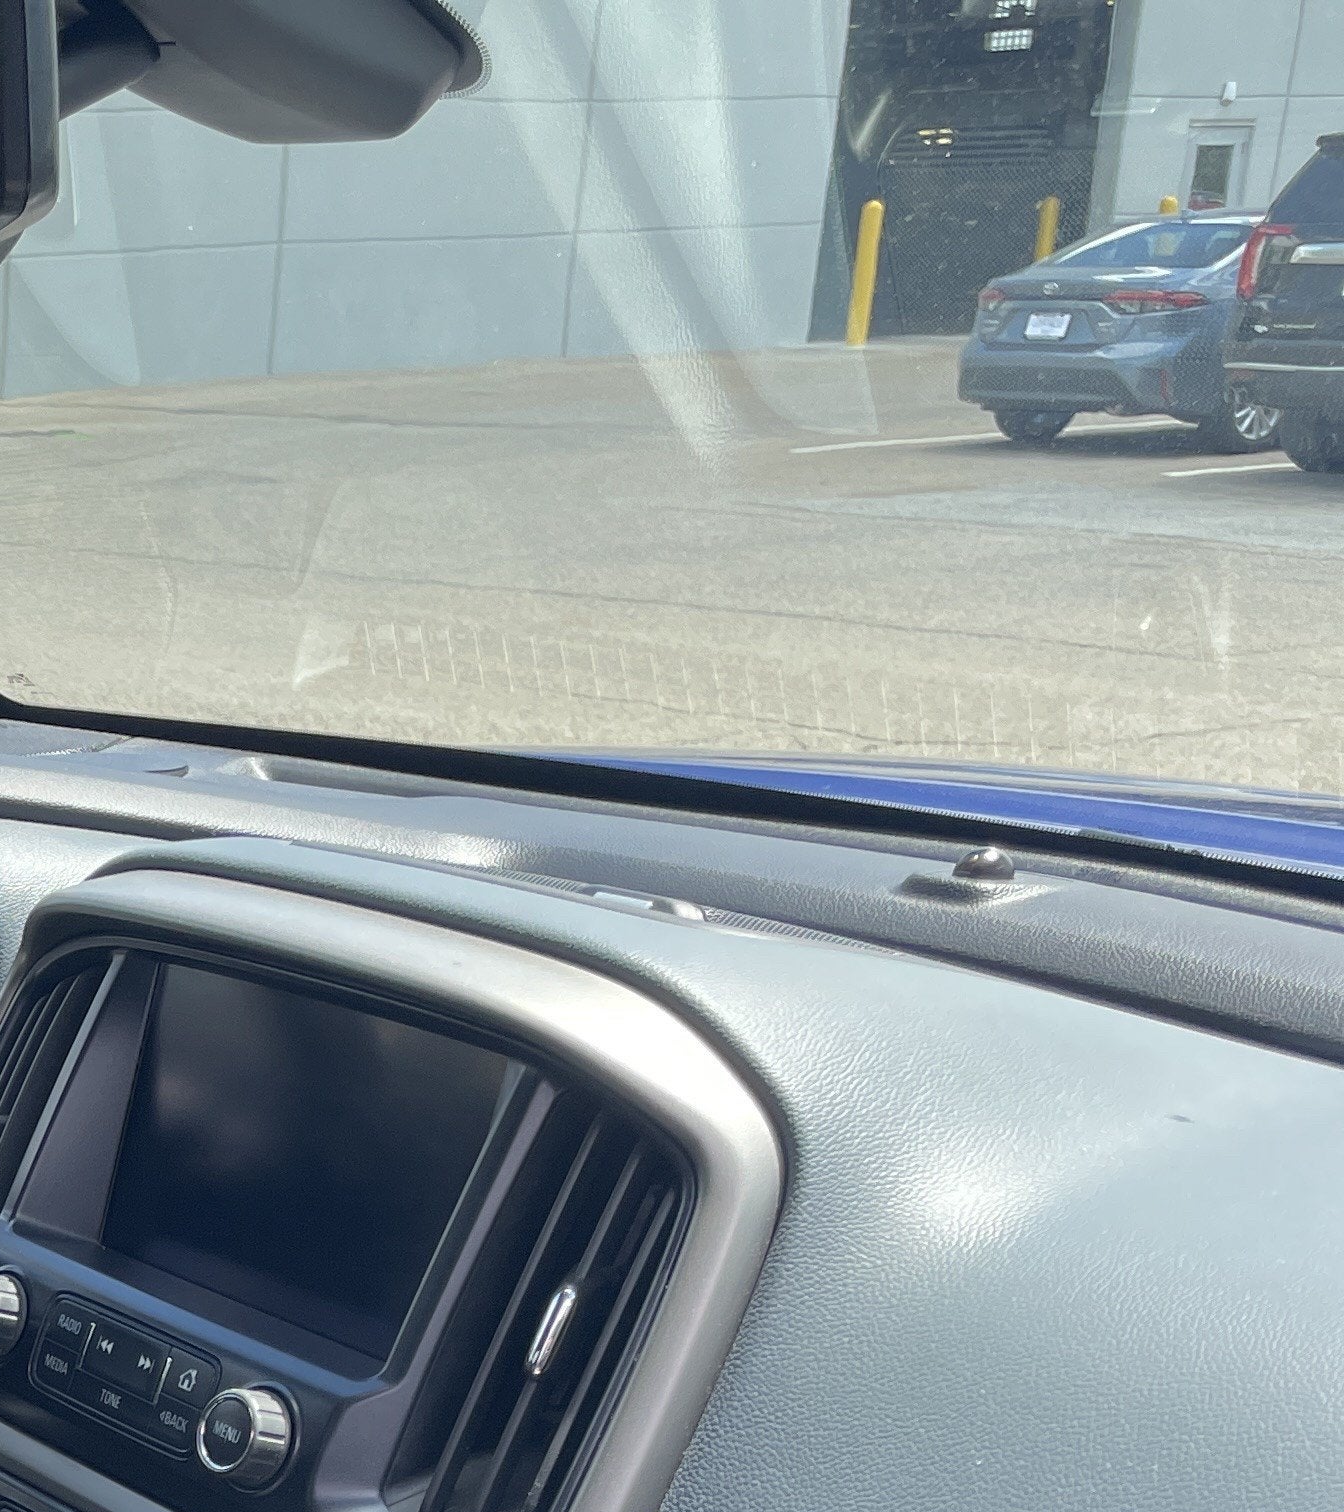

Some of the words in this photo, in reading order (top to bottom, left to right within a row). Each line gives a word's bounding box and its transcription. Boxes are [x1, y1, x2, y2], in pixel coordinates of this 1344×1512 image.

[57, 1314, 82, 1335] RADIO
[44, 1353, 69, 1376] MEDIA
[100, 1388, 122, 1410] TONE
[212, 1420, 242, 1444] MENU
